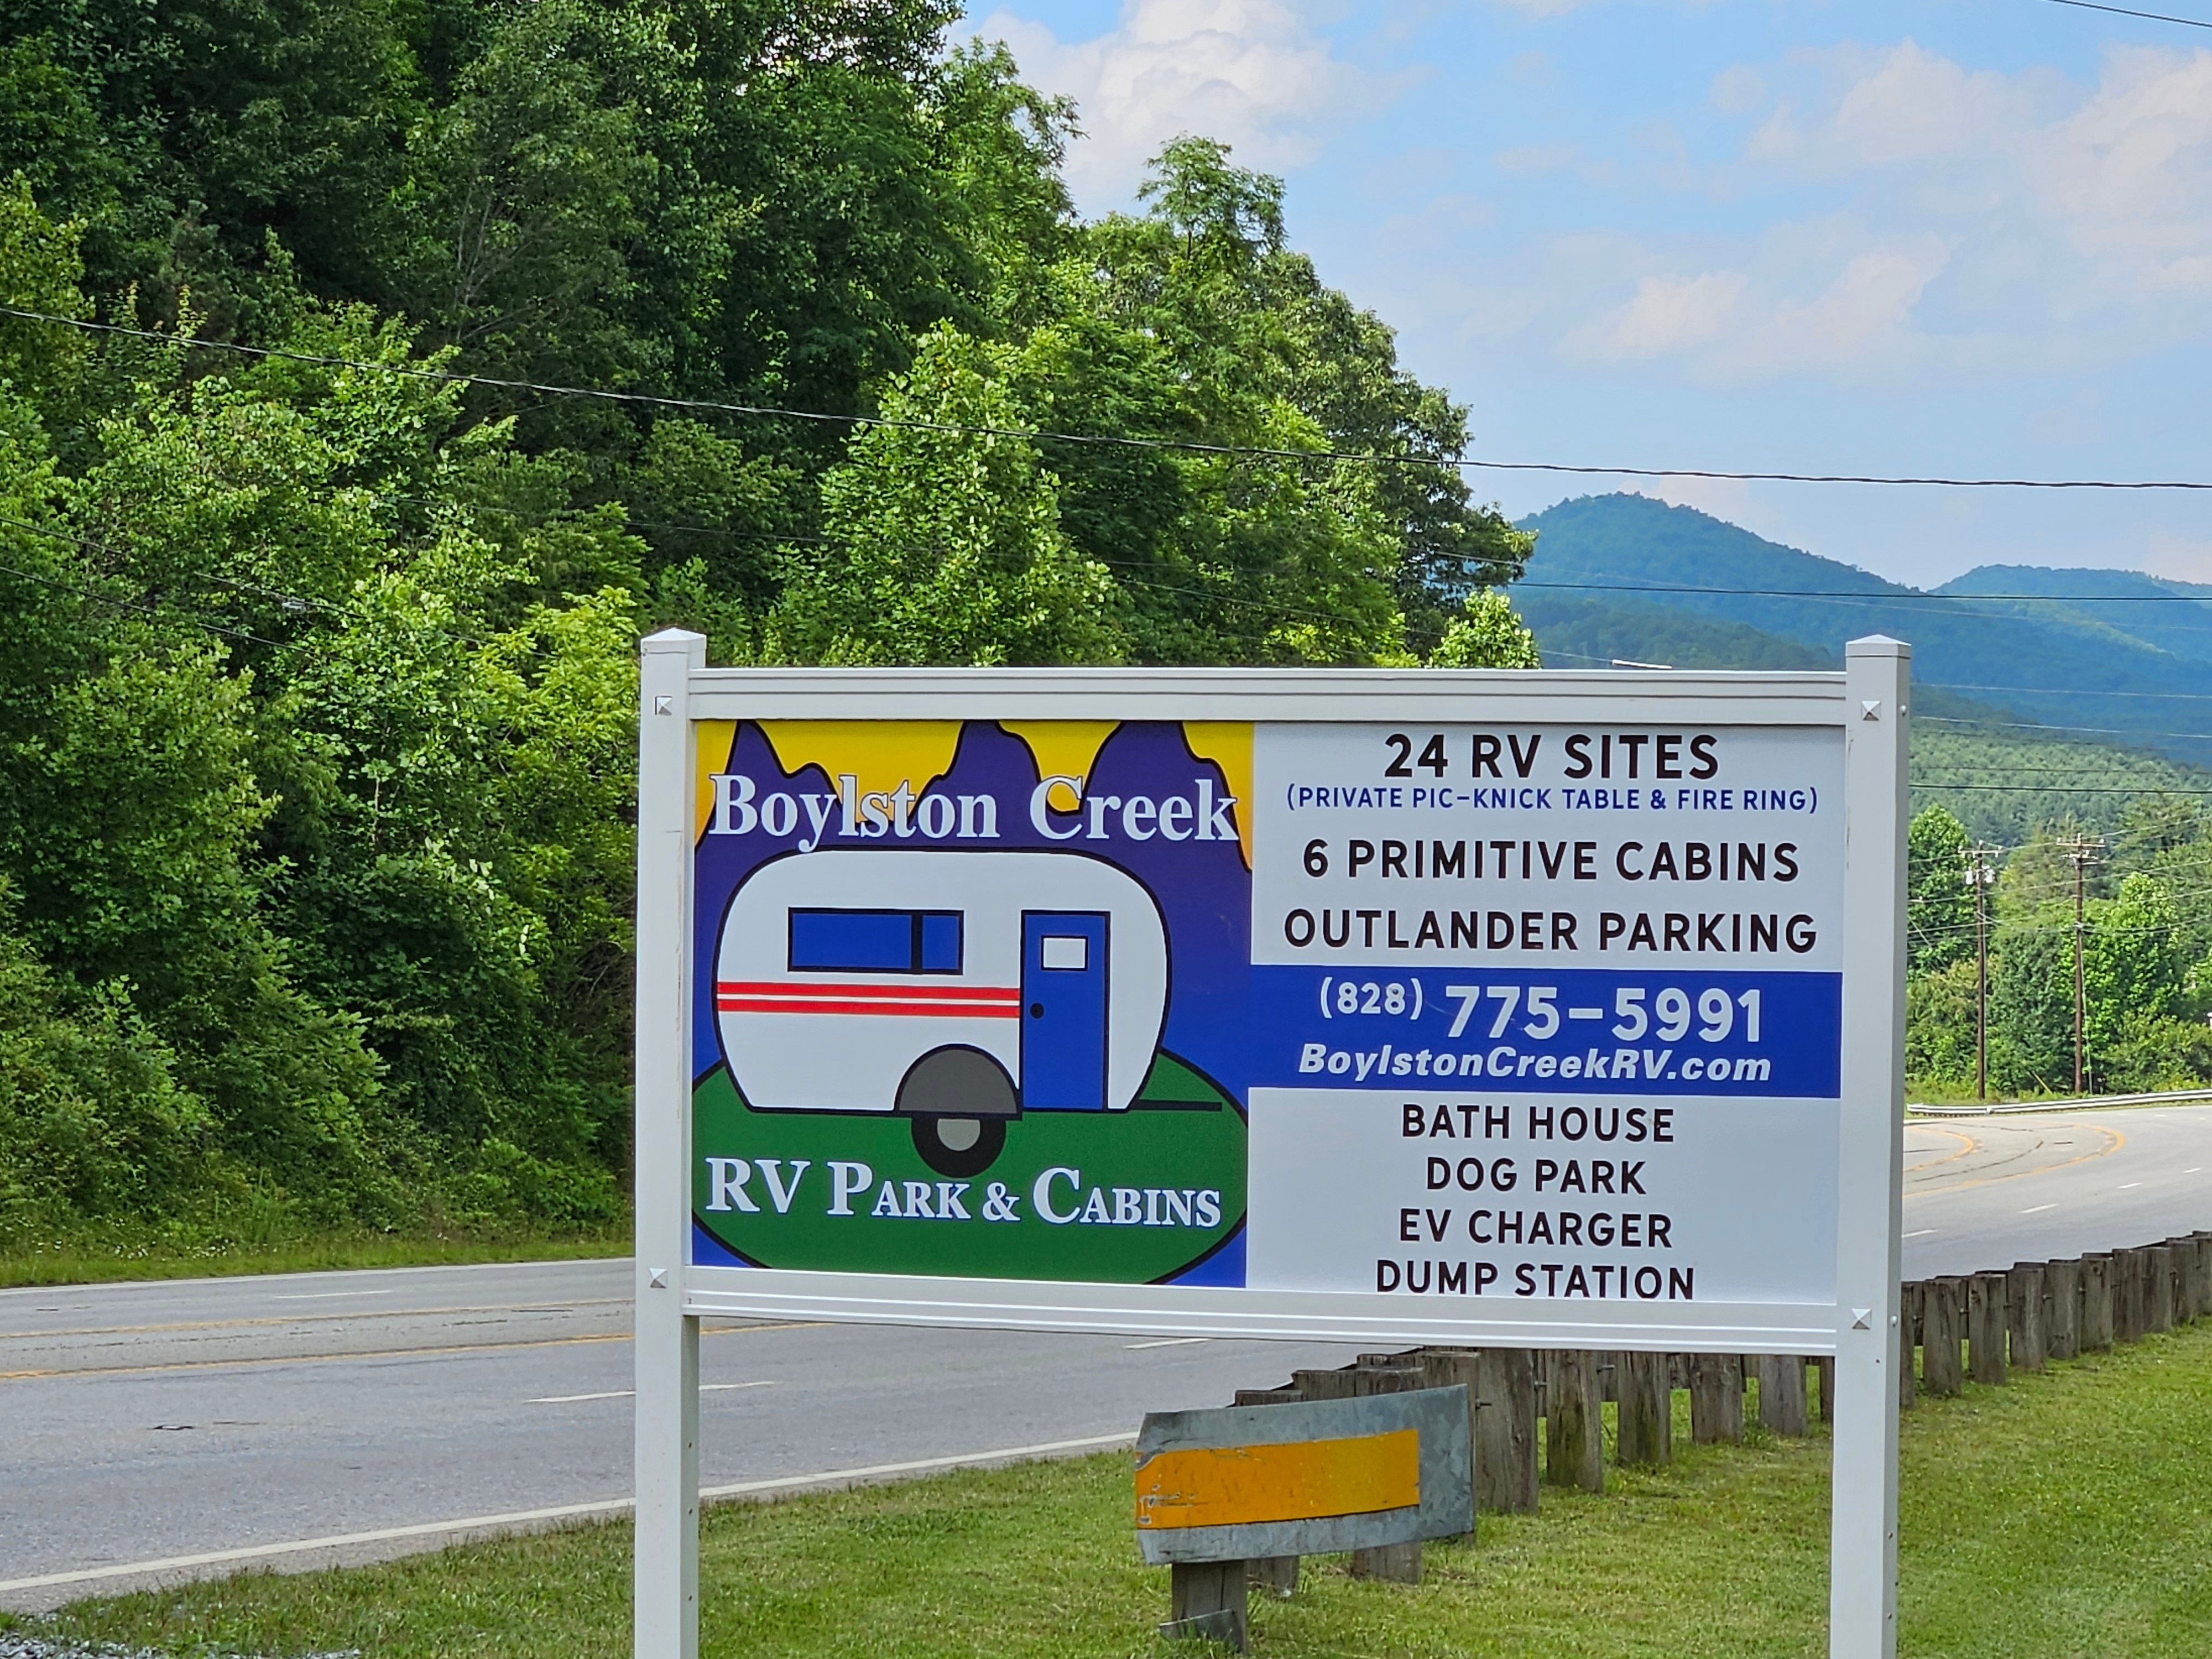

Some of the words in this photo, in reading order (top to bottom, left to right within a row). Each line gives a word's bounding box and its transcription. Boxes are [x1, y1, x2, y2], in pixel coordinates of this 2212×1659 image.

[1385, 733, 1449, 778] 24
[1473, 734, 1541, 779] RV
[1564, 734, 1719, 780] SITES
[708, 773, 999, 853] Boylston
[1030, 776, 1239, 841] Creek
[1287, 784, 1402, 810] (PRIVATE
[1413, 787, 1552, 809] PIC-KNICK
[1562, 789, 1640, 810] TABLE
[1650, 790, 1666, 811] &
[1678, 790, 1733, 810] FIRE
[1743, 787, 1818, 813] RING)
[1303, 839, 1329, 878] 6
[1349, 840, 1598, 880] PRIMITIVE
[1616, 842, 1799, 882] CABINS
[1284, 909, 1577, 951] OUTLANDER
[1600, 913, 1817, 953] PARKING
[1321, 977, 1422, 1020] (828)
[1446, 987, 1761, 1042] 775-5991
[1298, 1044, 1771, 1082] BoylstonCreekRV.com
[1402, 1104, 1510, 1139] BATH
[1530, 1107, 1674, 1142] HOUSE
[706, 1157, 810, 1213] RV
[827, 1161, 971, 1219] PARK
[982, 1182, 1020, 1222] &
[1032, 1167, 1221, 1227] CABINS
[1427, 1156, 1517, 1191] DOG
[1536, 1160, 1646, 1194] PARK
[1400, 1208, 1452, 1241] EV
[1469, 1210, 1672, 1248] CHARGER
[1377, 1260, 1498, 1295] DUMP
[1515, 1264, 1694, 1300] STATION
